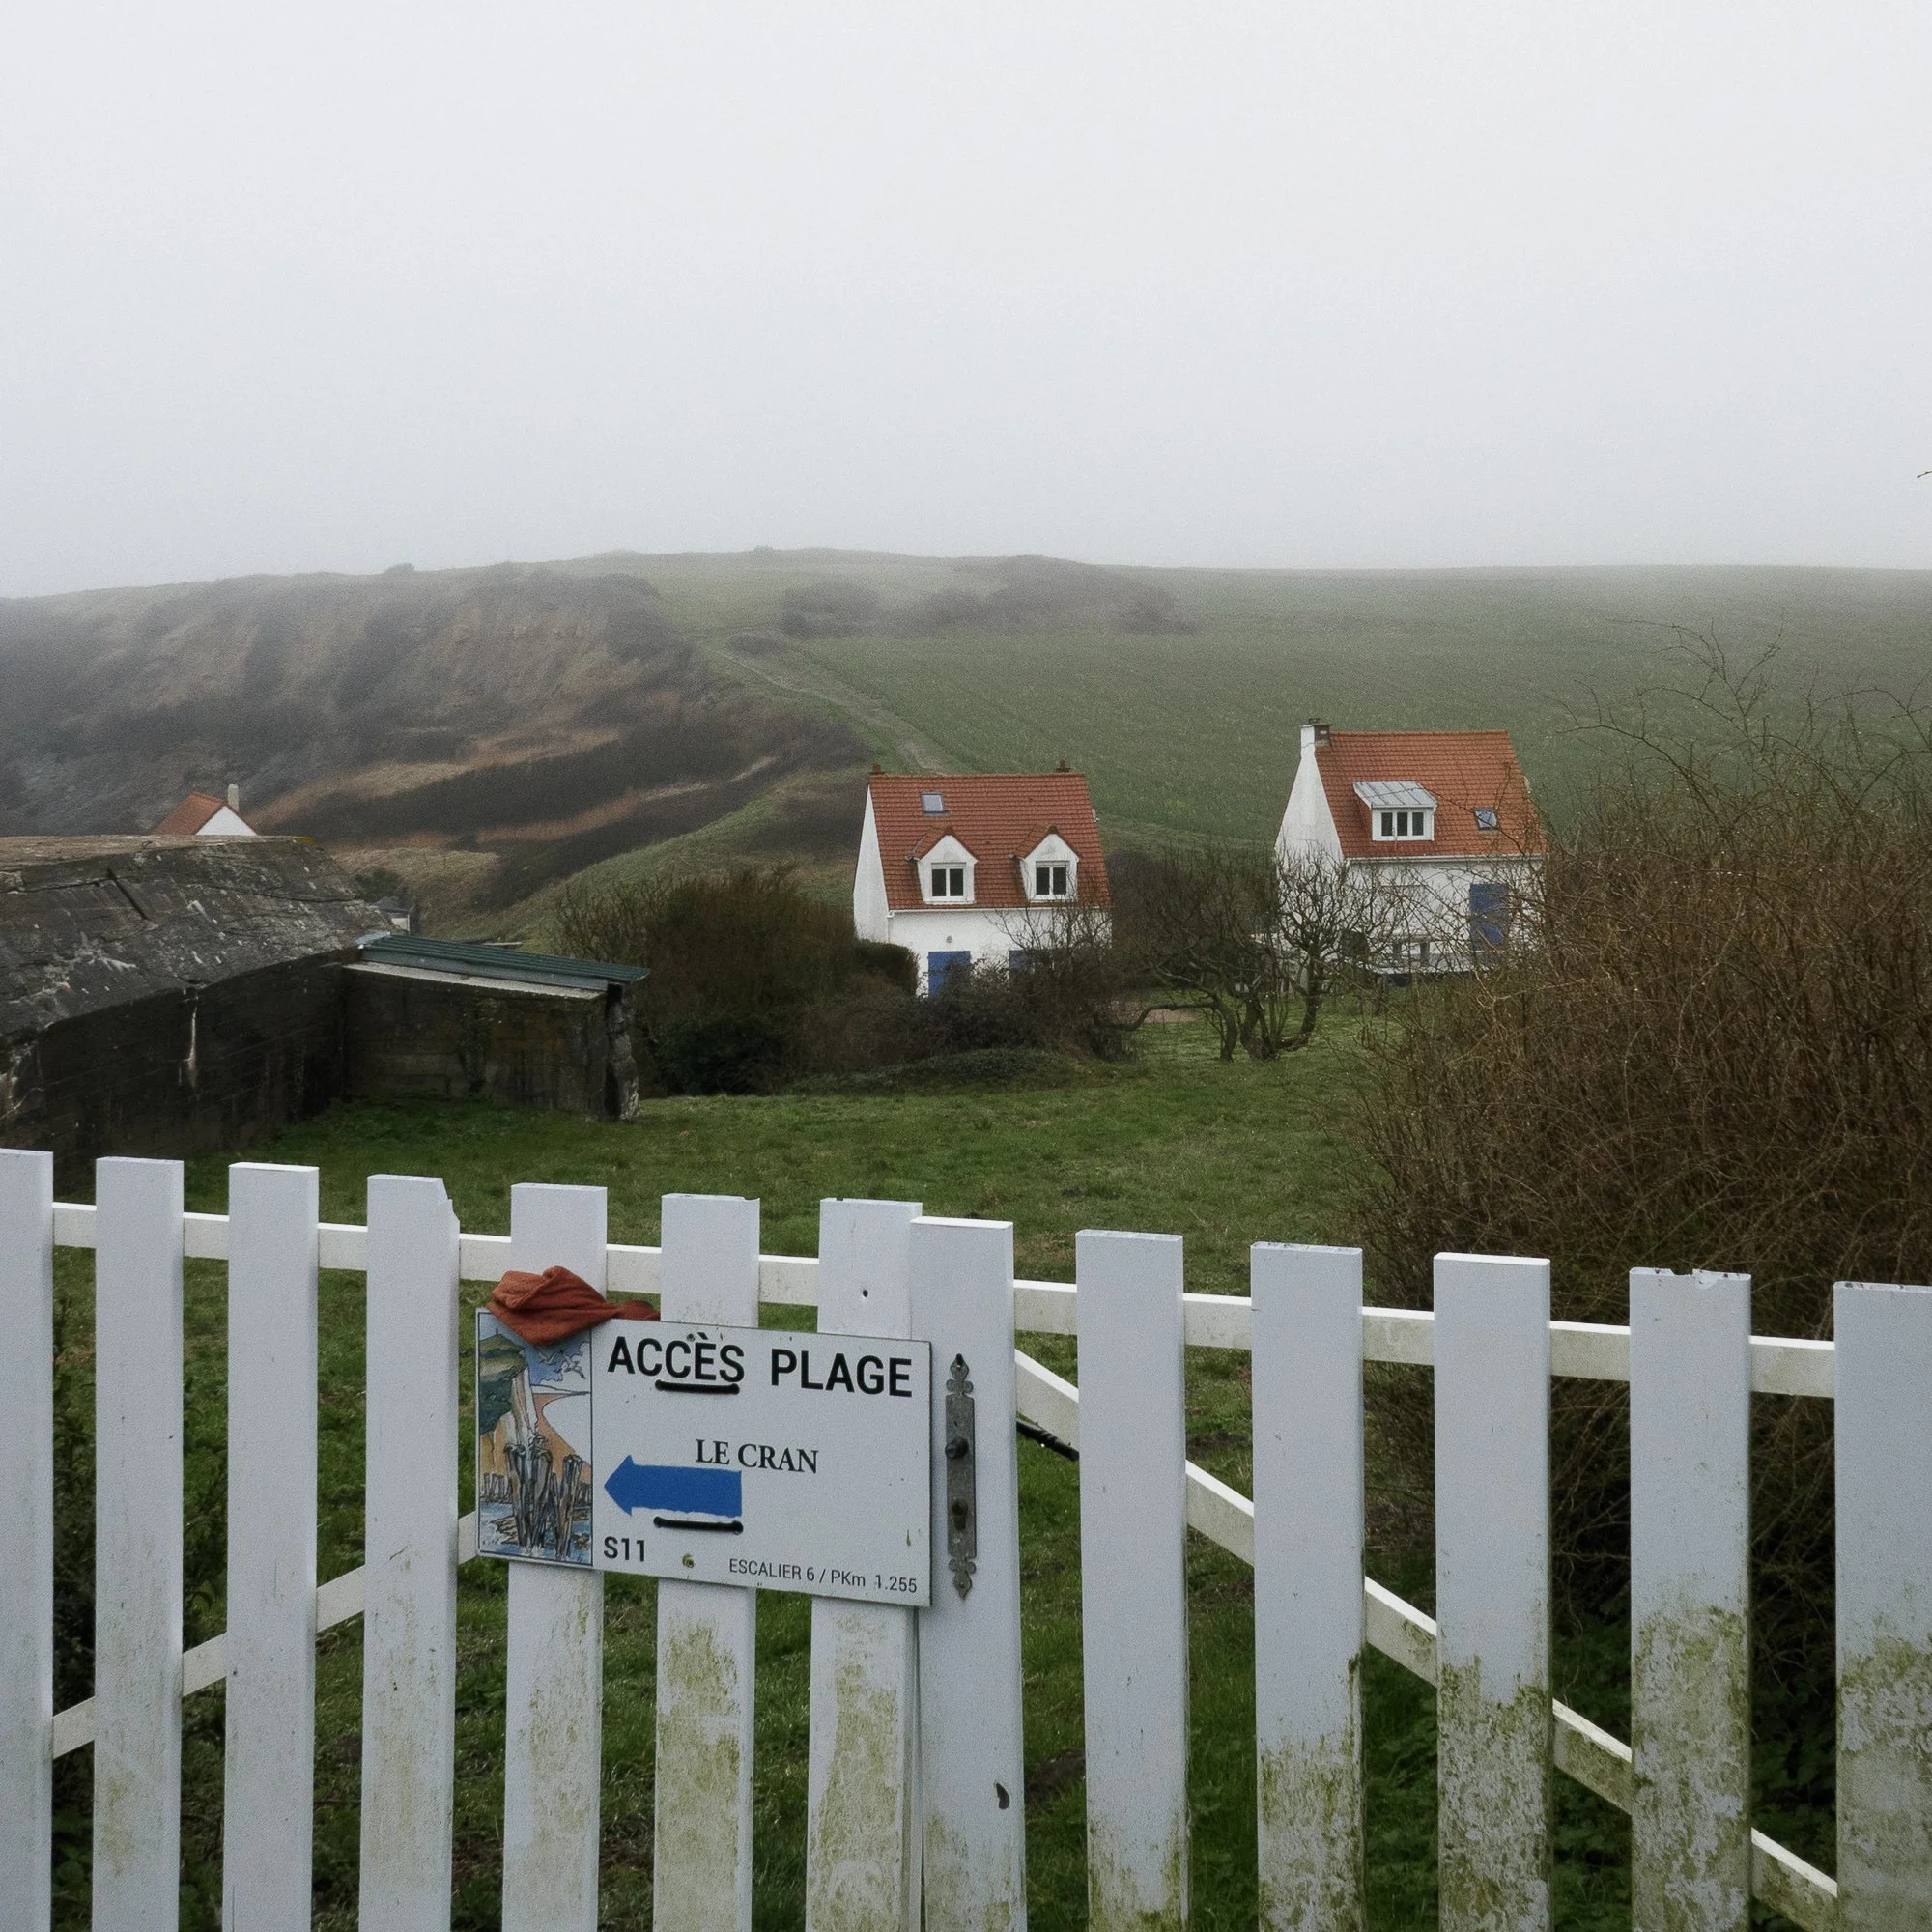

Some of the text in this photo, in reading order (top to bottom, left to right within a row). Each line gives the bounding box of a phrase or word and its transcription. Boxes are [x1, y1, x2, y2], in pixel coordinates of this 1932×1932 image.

[607, 1332, 913, 1398] ACCÈS PLAGE
[695, 1438, 819, 1474] LE CRAN
[603, 1535, 646, 1563] S11
[728, 1557, 919, 1594] ESCALIER 6 / PKm 1.255
